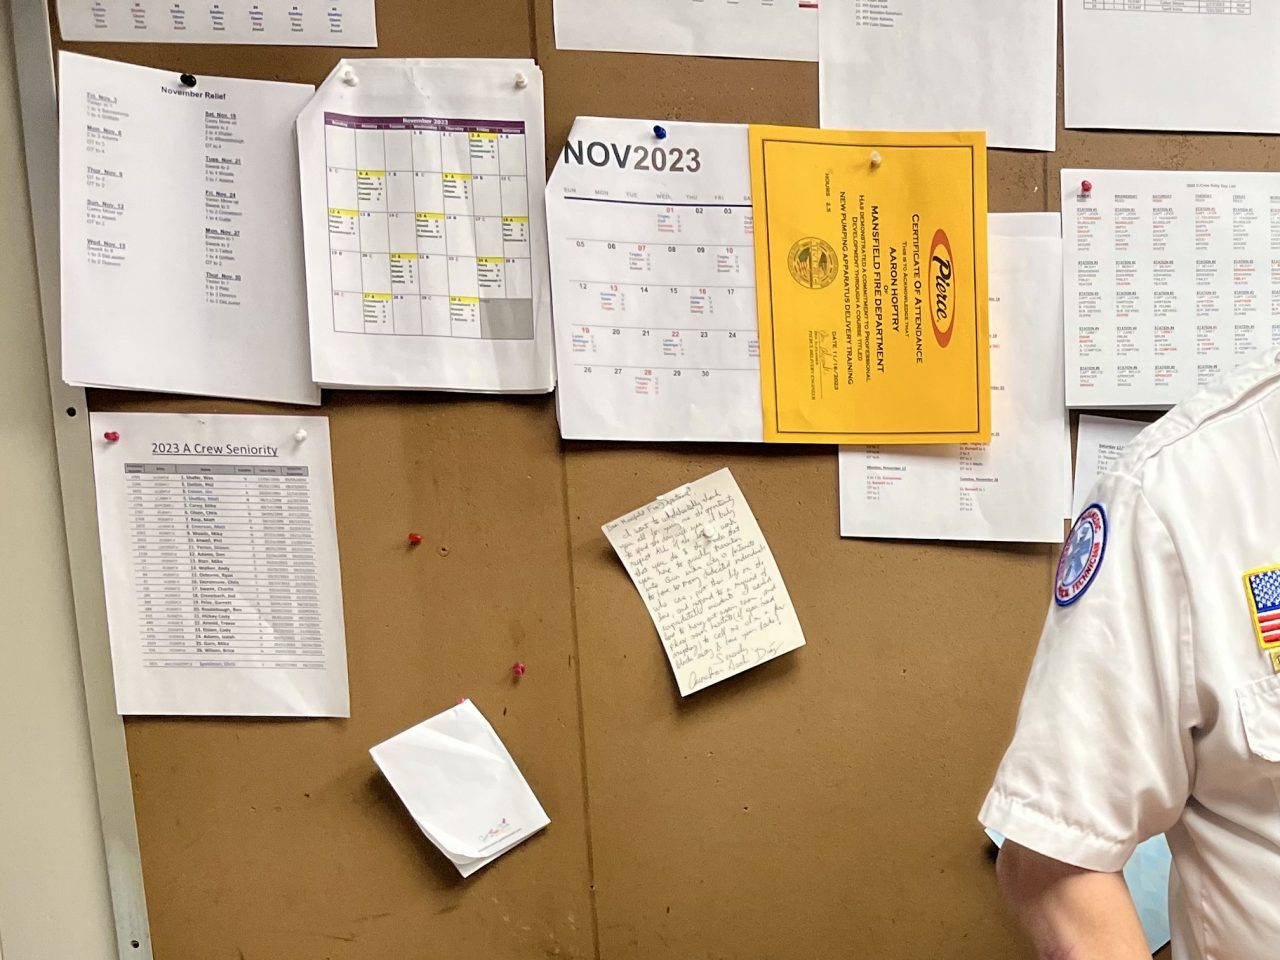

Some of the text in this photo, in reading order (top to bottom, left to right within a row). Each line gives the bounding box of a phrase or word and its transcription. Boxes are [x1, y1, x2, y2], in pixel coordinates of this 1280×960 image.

[161, 87, 226, 100] November Relief
[402, 117, 432, 125] November
[695, 207, 704, 215] 02
[839, 191, 847, 212] NEW
[842, 253, 851, 303] APPARATUS
[932, 255, 952, 320] Pierce
[871, 205, 885, 373] MANSFIELD FIRE DEPARTMENT
[889, 247, 900, 332] AARON HOPTRY
[152, 443, 279, 457] 2023 A Crew Seniority
